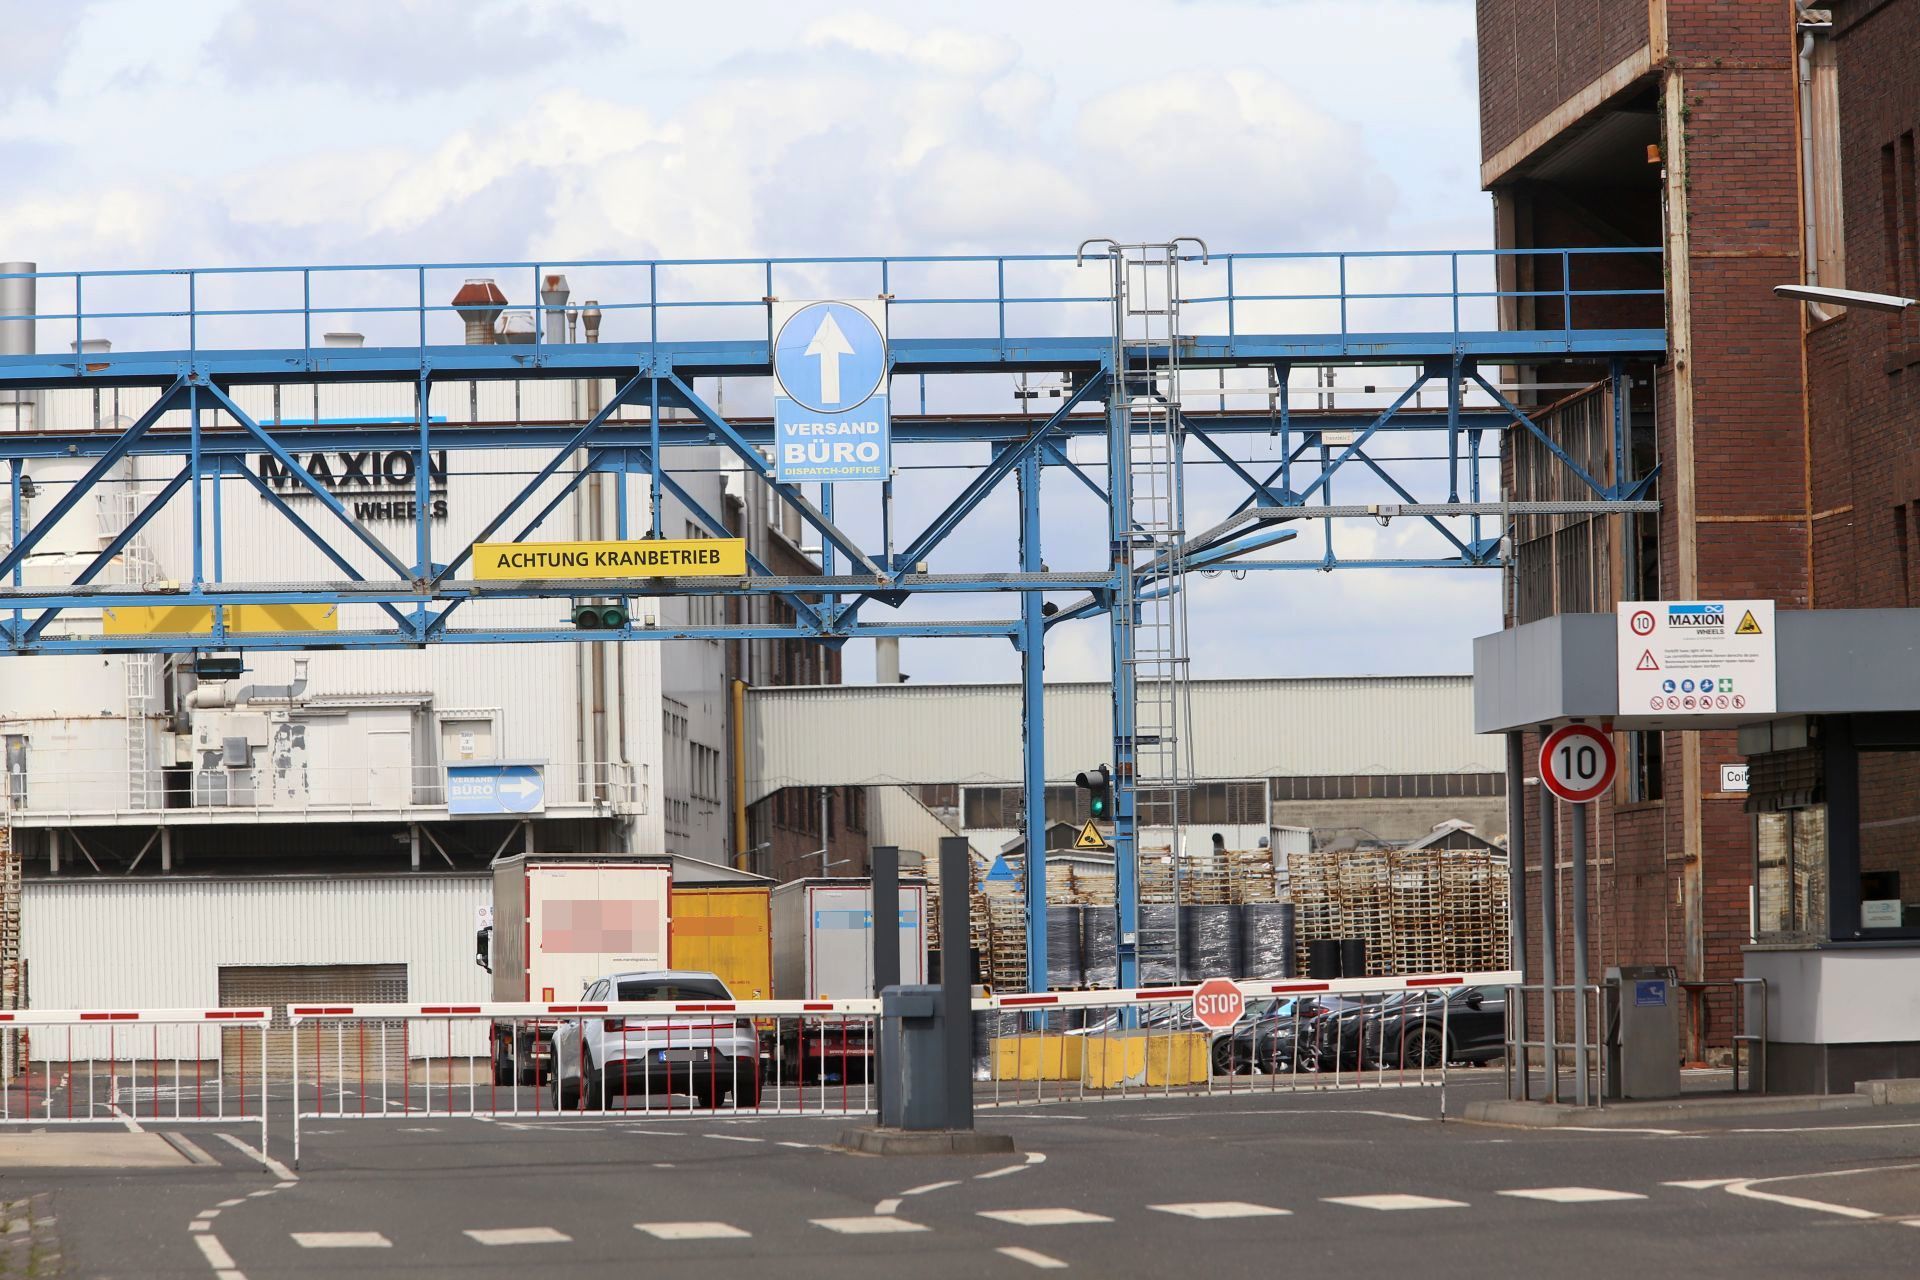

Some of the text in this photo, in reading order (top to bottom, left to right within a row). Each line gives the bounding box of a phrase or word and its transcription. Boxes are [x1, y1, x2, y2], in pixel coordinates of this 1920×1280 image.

[784, 422, 880, 436] VERSAND
[784, 439, 880, 464] BÜRO
[784, 466, 881, 476] DISPATCH-OFFICE
[354, 501, 448, 519] WHEES
[497, 549, 721, 568] ACHTUNG KRANBETRIEB
[1636, 617, 1650, 630] 10
[1668, 614, 1724, 626] MAXION
[1560, 745, 1597, 780] 10
[452, 784, 493, 795] BÜRO
[1198, 993, 1239, 1015] STOP
